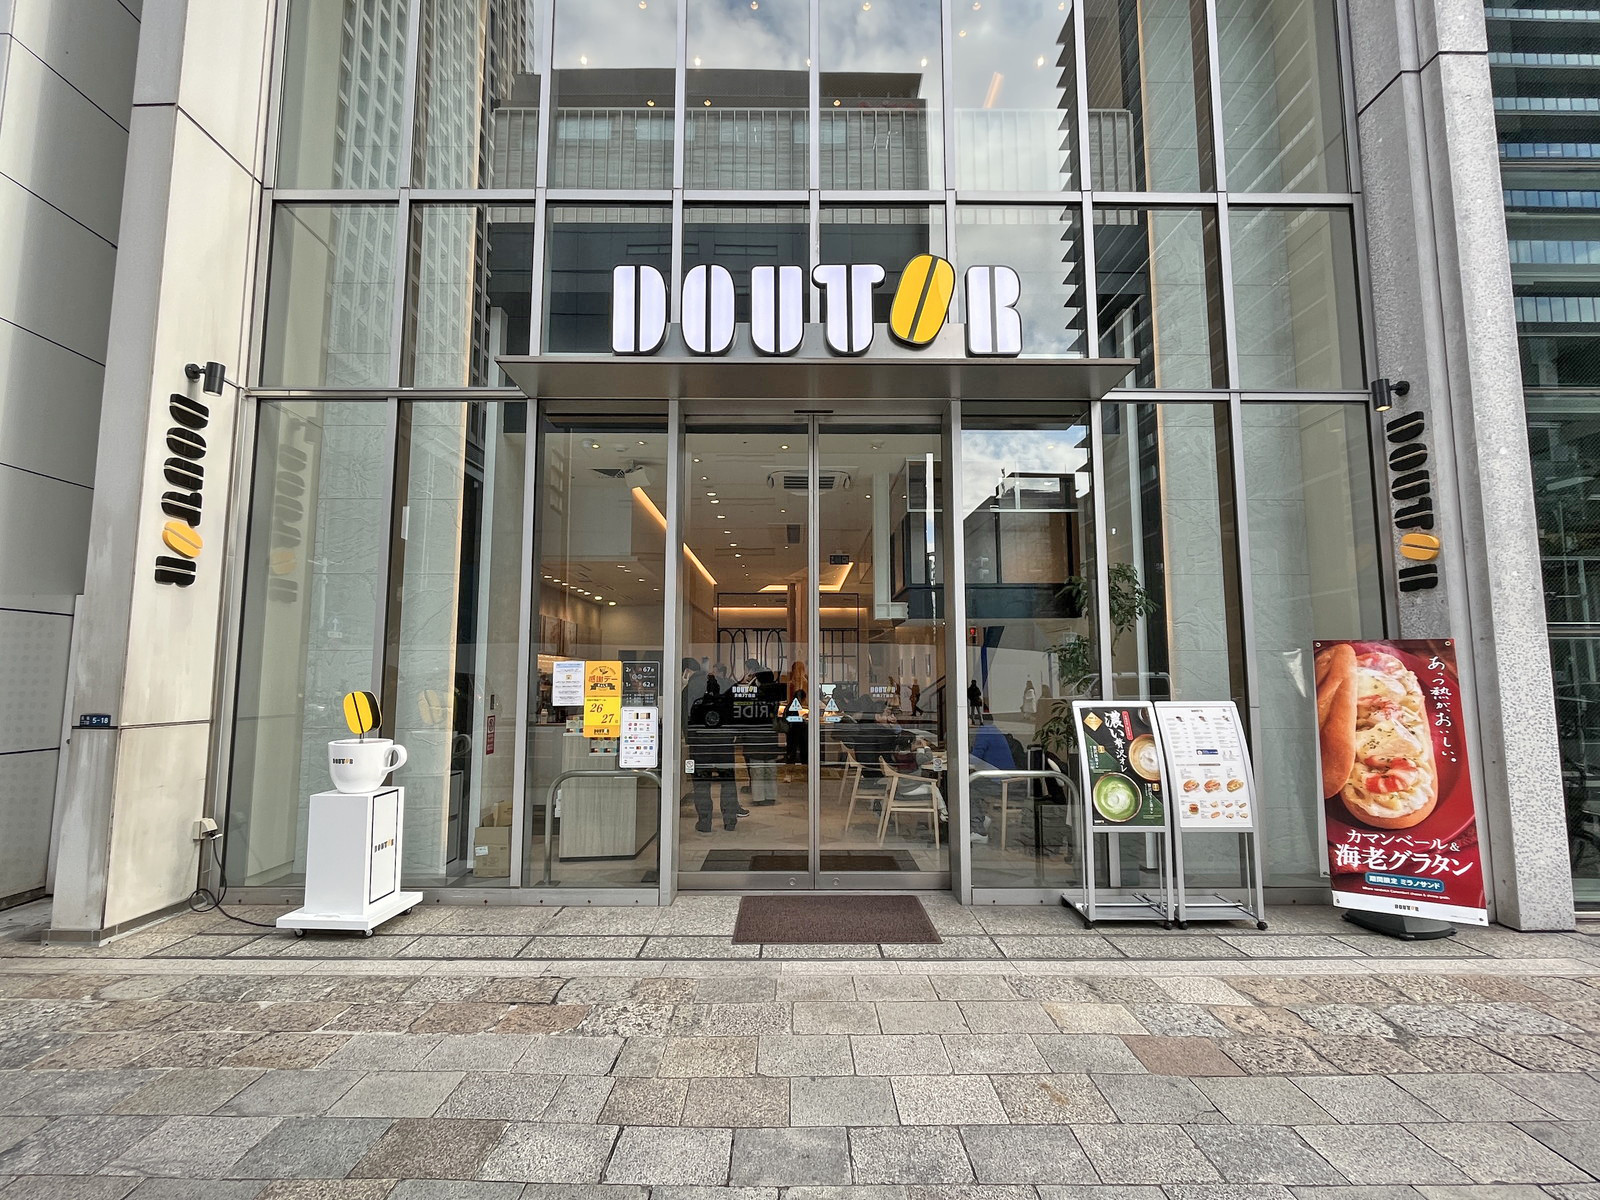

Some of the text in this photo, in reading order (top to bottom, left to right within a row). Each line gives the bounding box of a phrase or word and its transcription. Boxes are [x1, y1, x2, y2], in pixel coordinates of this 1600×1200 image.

[612, 253, 1023, 356] DOUTOR
[154, 393, 209, 588] DOUTOR
[1386, 410, 1440, 592] DOUTOR
[590, 703, 604, 713] 26
[601, 714, 614, 724] 27
[1334, 843, 1474, 876] 海老グラタン
